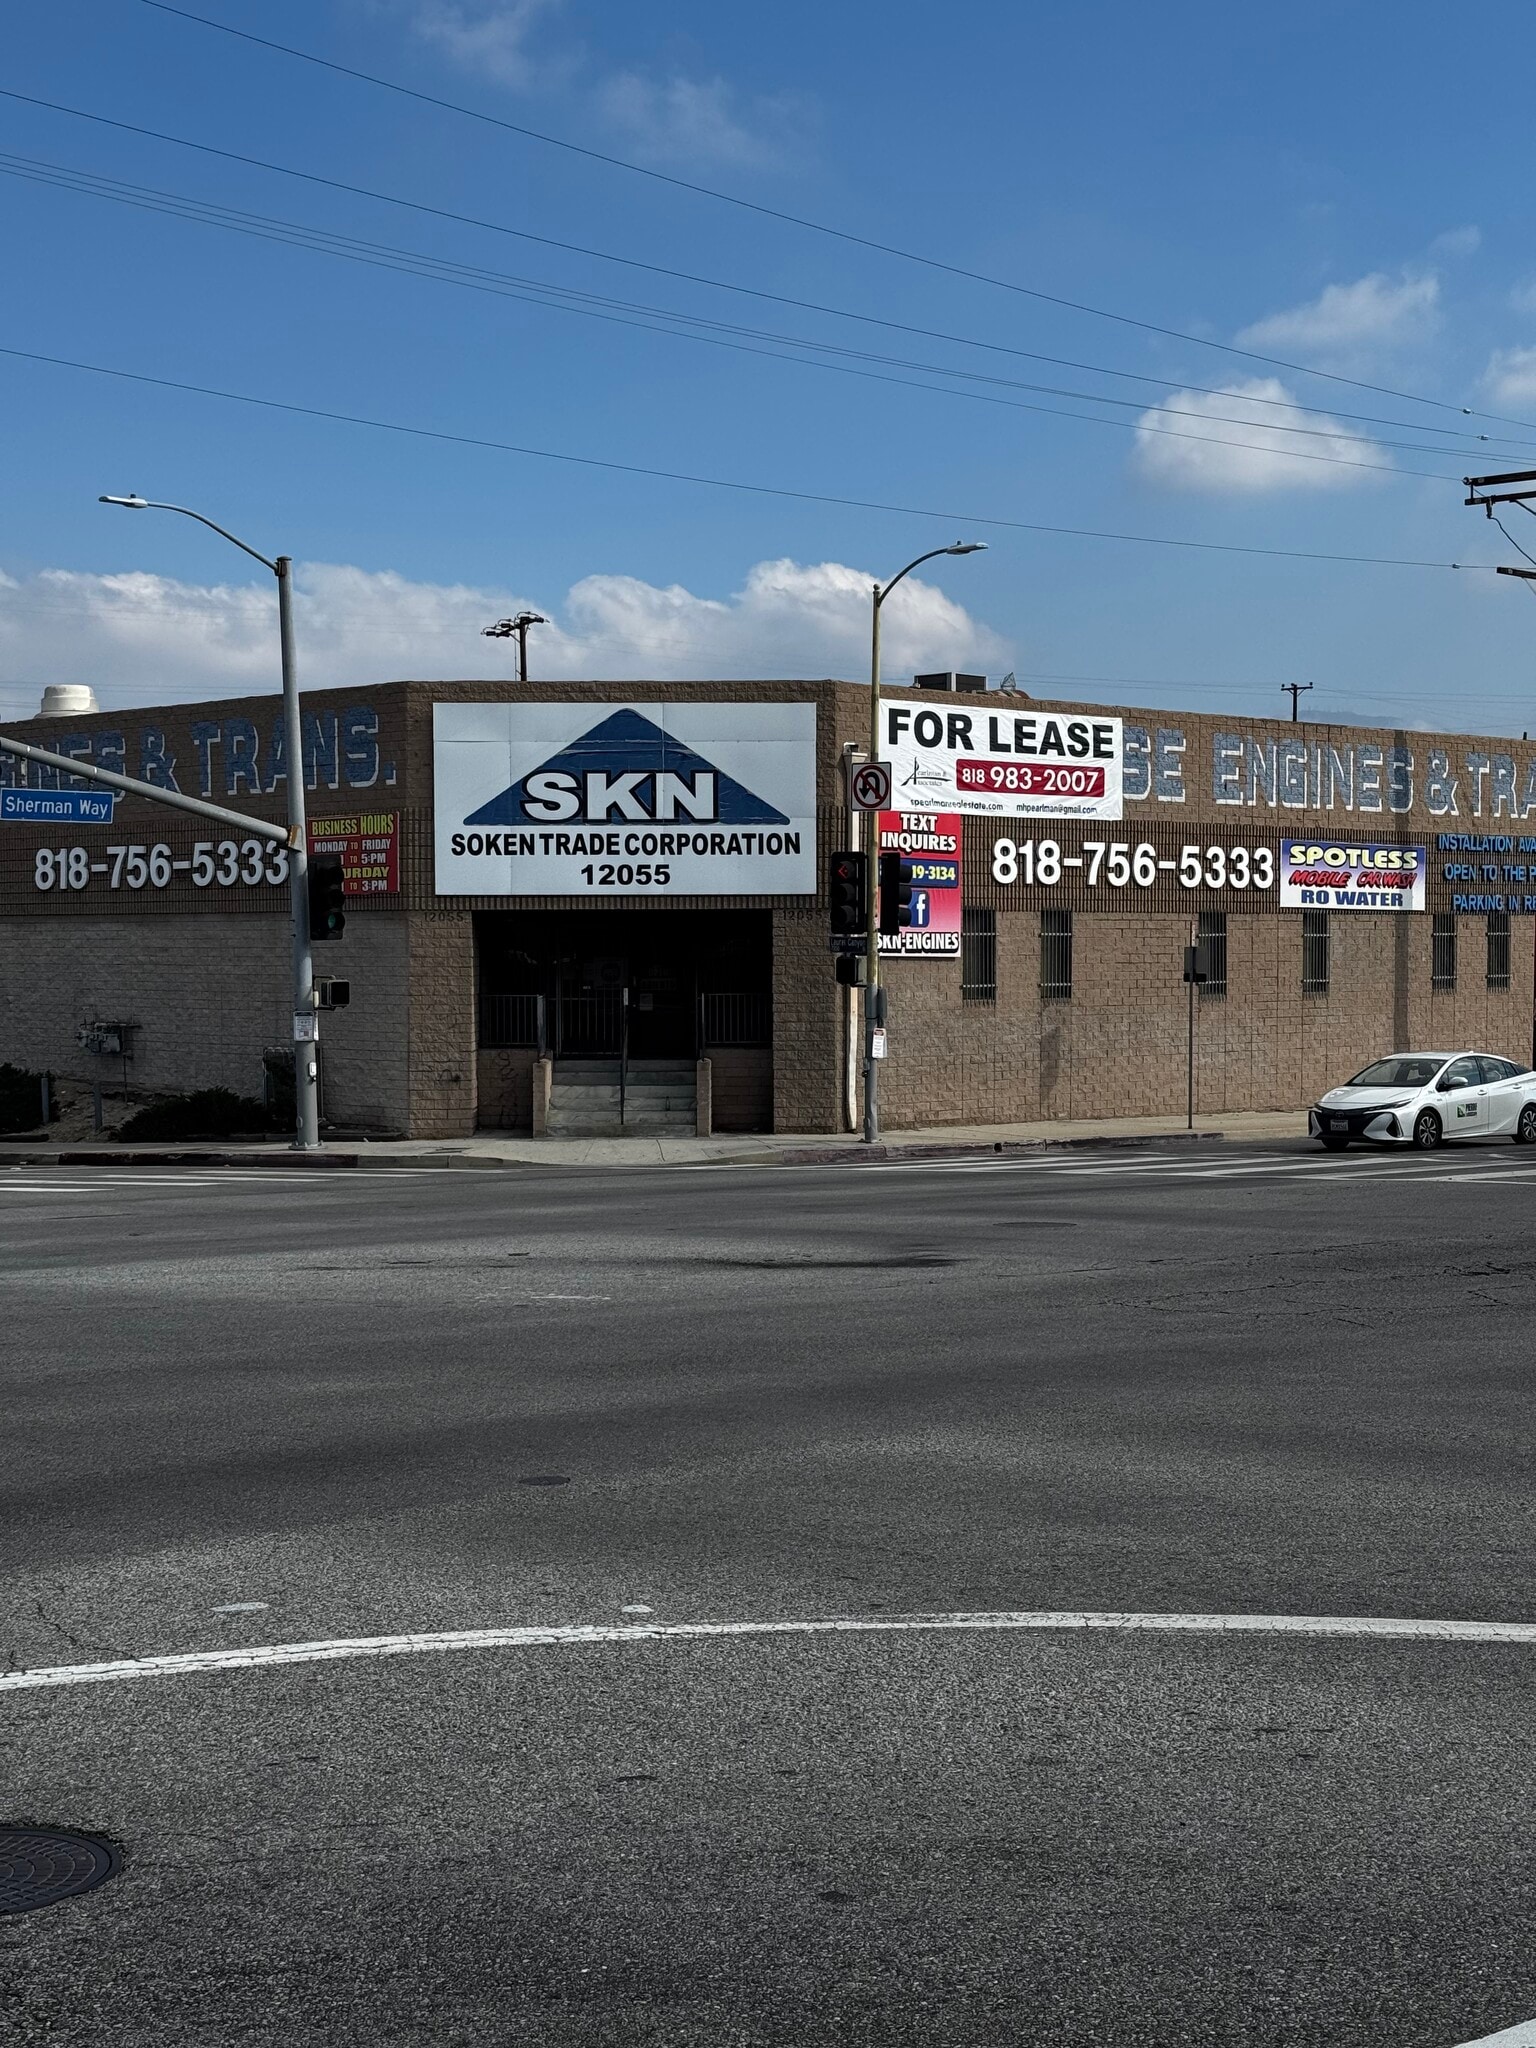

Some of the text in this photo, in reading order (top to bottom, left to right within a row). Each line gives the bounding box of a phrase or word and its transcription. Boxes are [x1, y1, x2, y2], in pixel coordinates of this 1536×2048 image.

[888, 708, 1114, 759] FOR LEASE
[139, 725, 182, 801] &
[190, 704, 397, 797] TRANS.
[962, 766, 1099, 793] 818 983-2007
[1212, 731, 1414, 814] ENGINES
[1424, 749, 1460, 816] &
[521, 769, 719, 825] SKN
[5, 796, 108, 819] Sherman Way
[312, 814, 394, 836] BUSINESS HOURS
[900, 813, 938, 832] TEXT
[313, 838, 391, 853] MONDAY TO FRIDAY
[451, 831, 801, 857] SOKEN TRADE CORPORATION
[881, 832, 957, 852] INQUIRES
[1438, 833, 1514, 852] INSTALLATION
[34, 839, 290, 891] 818-756-5333
[349, 855, 358, 864] TO
[361, 852, 386, 865] 5:PM
[992, 837, 1274, 890] 818-756-5333
[1289, 845, 1418, 870] SPOTLESS
[580, 864, 671, 886] 12055
[911, 865, 956, 881] 19-3134
[1289, 870, 1417, 889] MOBILE CAR WASH
[1444, 863, 1476, 880] OPEN
[1482, 864, 1498, 881] TO
[1503, 865, 1526, 881] THE
[349, 882, 358, 890] TO
[361, 879, 388, 892] 3:PM
[1301, 889, 1403, 907] RO WATER
[1453, 894, 1503, 911] PARKING
[1508, 895, 1519, 911] IN
[424, 911, 464, 922] 12055
[783, 910, 823, 921] 12055
